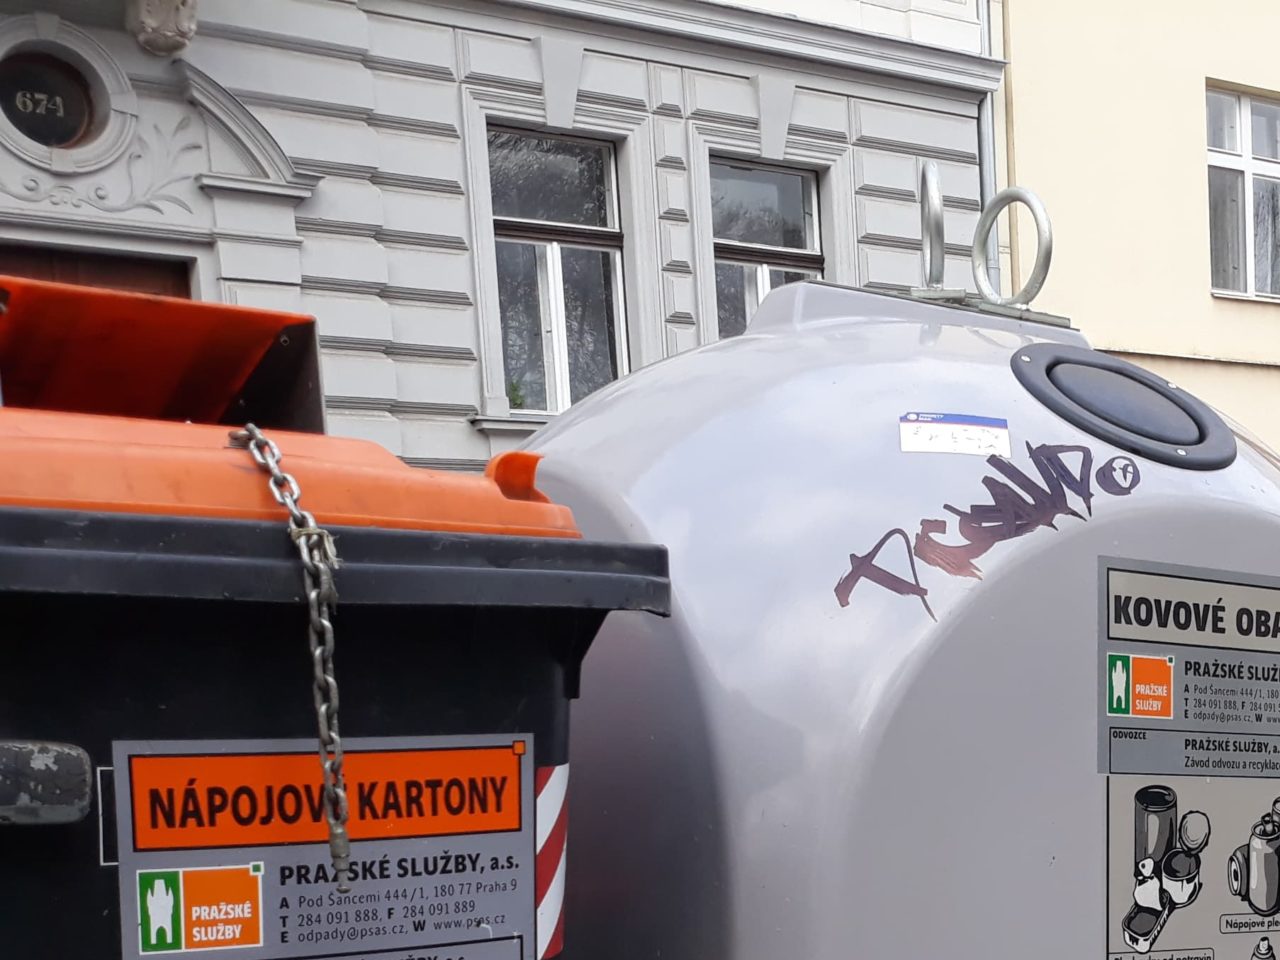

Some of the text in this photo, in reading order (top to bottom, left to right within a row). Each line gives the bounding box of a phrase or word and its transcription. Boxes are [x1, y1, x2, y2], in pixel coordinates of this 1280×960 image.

[15, 91, 65, 117] 674
[1113, 595, 1226, 634] KOVOVÉ
[1184, 659, 1244, 680] PRAŽSKÉ
[1135, 682, 1168, 697] PRAŽSKÉ
[1184, 684, 1189, 693] A
[1194, 684, 1207, 695] Pod
[1266, 689, 1279, 700] 180
[1135, 697, 1162, 712] SLUŽBY
[1193, 698, 1207, 708] 284
[1209, 699, 1222, 709] 091
[1223, 700, 1240, 711] 888,
[1249, 701, 1262, 711] 284
[1264, 702, 1276, 712] 091
[1255, 714, 1263, 723] W
[1112, 730, 1147, 740] ODVOZCE
[1184, 737, 1231, 752] PRAŽSKÉ
[1232, 739, 1271, 755] SLUŽBY,
[1184, 755, 1210, 769] Závod
[1211, 757, 1241, 769] odvozu
[1242, 761, 1247, 769] a
[149, 774, 507, 829] NÁPOJOV KARTONY
[397, 850, 485, 879] SLUŽBY,
[490, 855, 519, 871] a.s.
[280, 878, 518, 909] A Pod Šancemi 444/1, 180 77 Praha 9
[191, 900, 252, 921] PRAŽSKÉ
[280, 901, 475, 927] T 284 091 888, F 284 091 889
[193, 923, 242, 942] SLUŽBY
[281, 914, 505, 943] E odpady@psas.cz, W www.psas.cz
[1225, 918, 1266, 932] Nápojové
